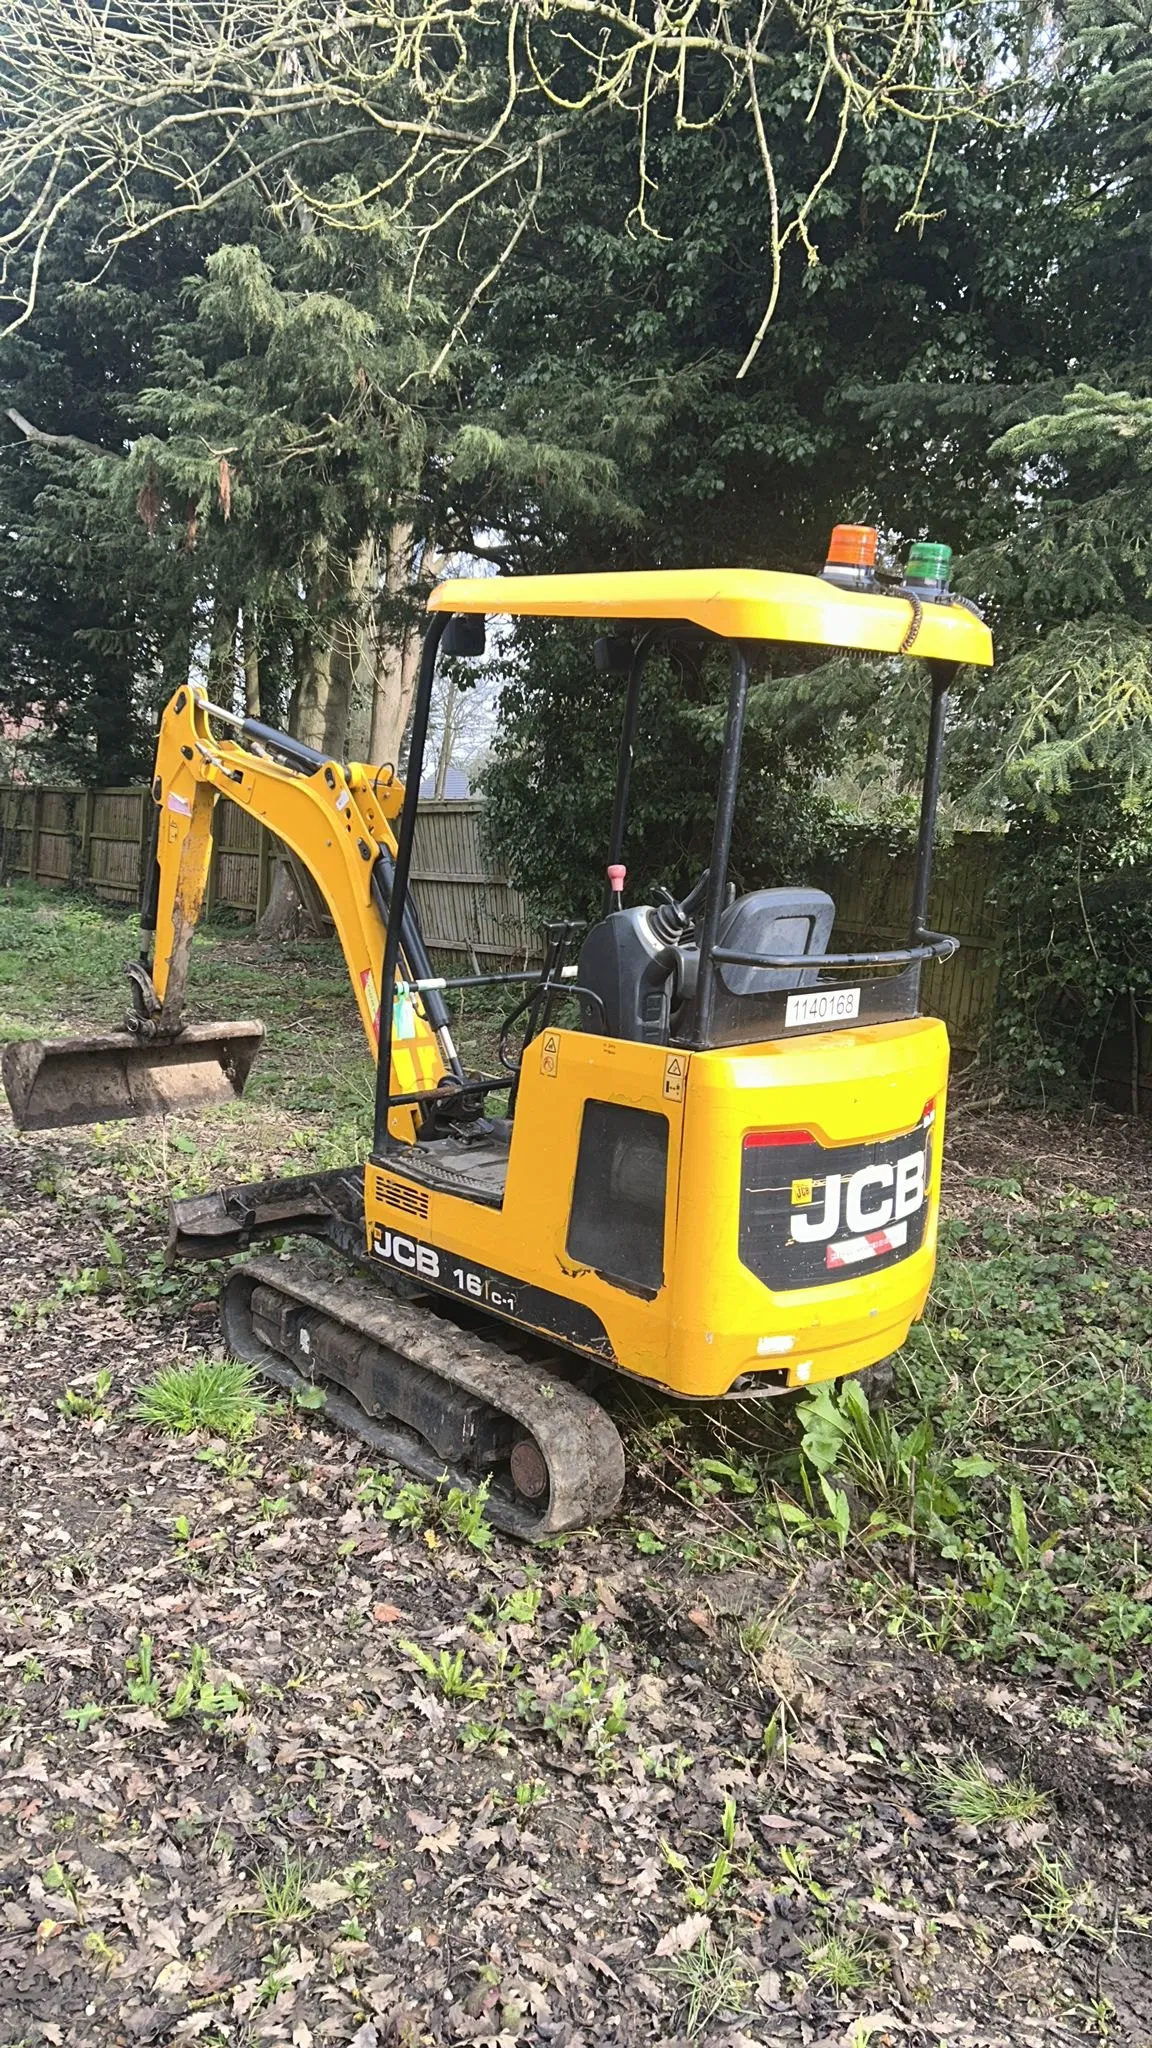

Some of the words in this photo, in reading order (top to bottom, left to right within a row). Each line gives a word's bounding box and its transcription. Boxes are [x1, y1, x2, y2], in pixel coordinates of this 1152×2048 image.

[793, 993, 855, 1021] 1140168
[789, 1150, 926, 1244] JCB
[373, 1231, 440, 1278] JCB
[453, 1268, 482, 1297] 16
